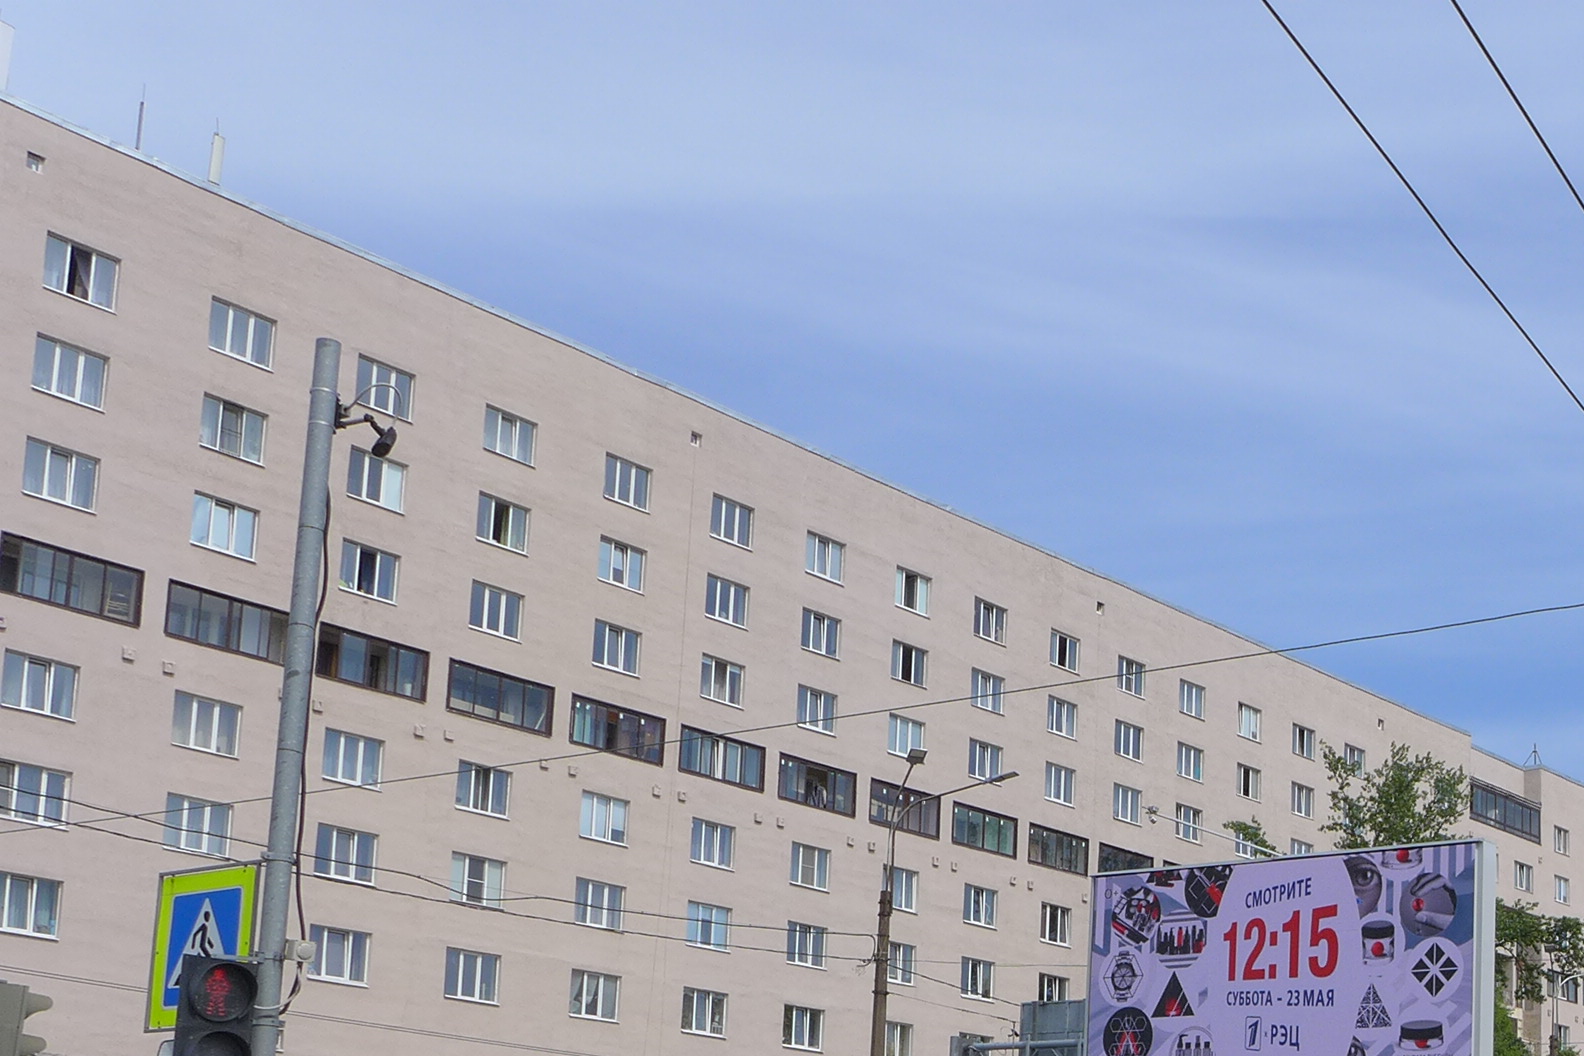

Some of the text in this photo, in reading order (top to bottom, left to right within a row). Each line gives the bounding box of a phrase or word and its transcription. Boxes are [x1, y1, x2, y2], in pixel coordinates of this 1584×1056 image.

[1245, 877, 1312, 908] СМОТРИТЕ
[1223, 904, 1339, 982] 12:15
[1226, 990, 1273, 1006] СУББОТА
[1286, 990, 1300, 1006] 23
[1303, 989, 1335, 1007] МАЯ
[1270, 1024, 1300, 1051] РЭЦ
